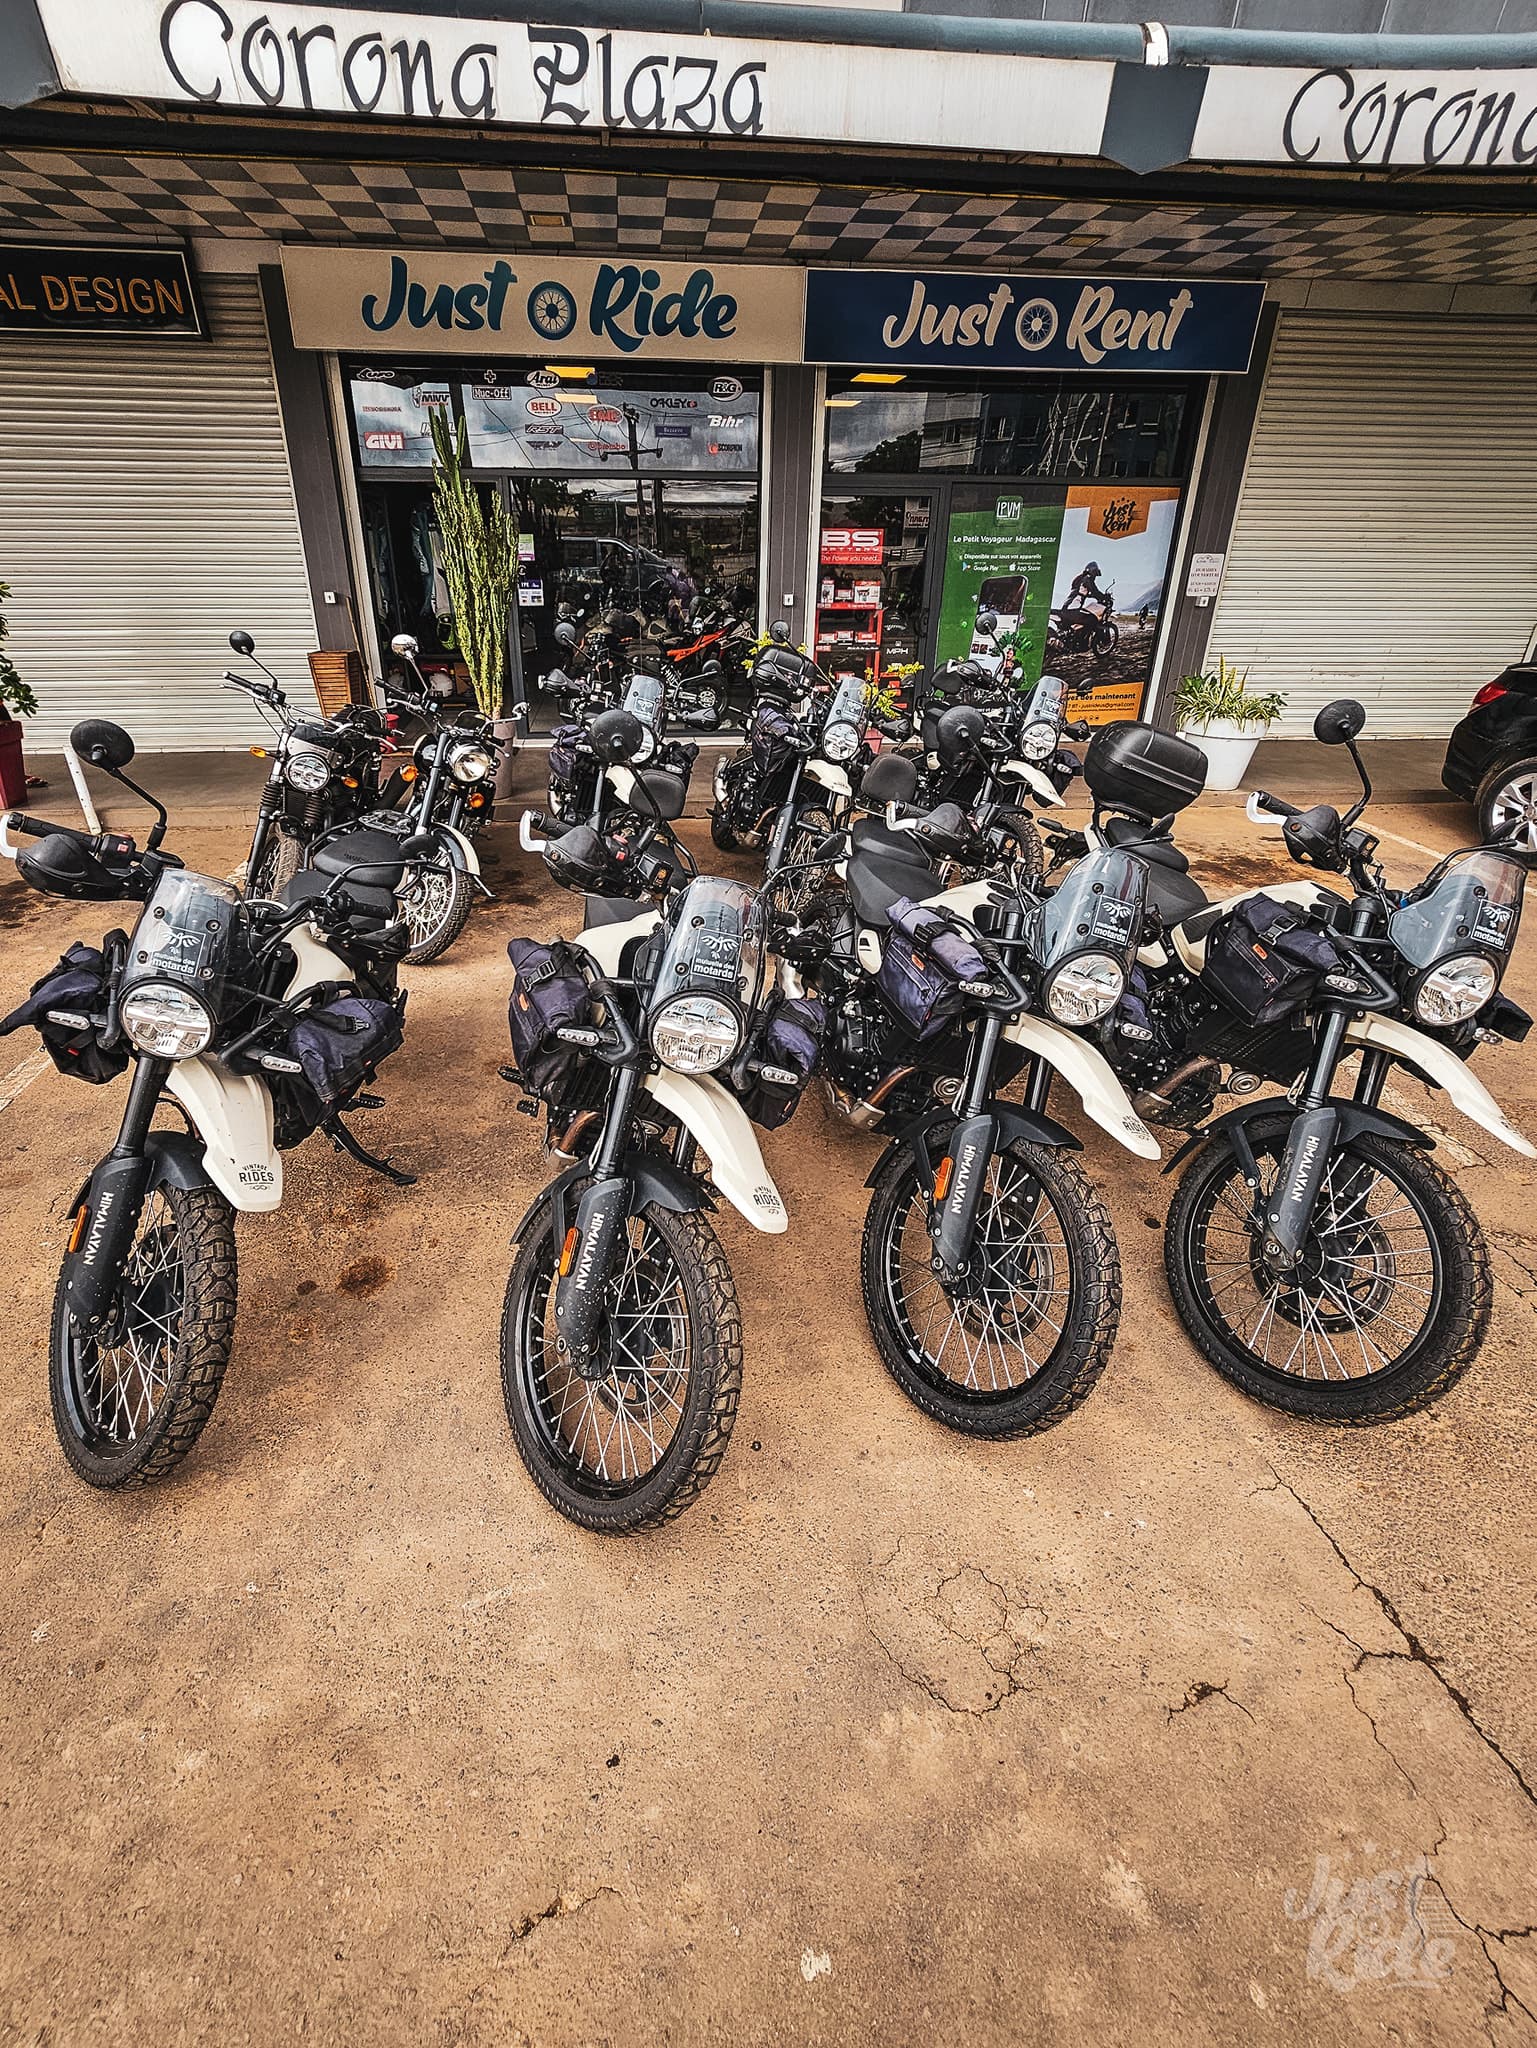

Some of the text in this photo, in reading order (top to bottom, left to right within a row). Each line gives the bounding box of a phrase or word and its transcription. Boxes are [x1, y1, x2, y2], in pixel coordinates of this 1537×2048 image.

[160, 0, 767, 136] Corona Plaza
[41, 275, 185, 314] DESIGN
[361, 256, 738, 352] Just Ride
[882, 280, 1194, 364] Just Rent
[530, 371, 559, 384] Arai
[474, 388, 509, 399] Muc-Off
[713, 381, 737, 394] R&G
[531, 402, 557, 411] BELL
[650, 398, 687, 408] OAKLEY
[707, 414, 744, 428] Bihr
[366, 434, 403, 449] GIVI
[1103, 500, 1136, 518] Just
[1102, 516, 1134, 534] Rent
[821, 530, 880, 547] BS
[963, 535, 979, 543] Petit
[981, 536, 1013, 544] Voyageur
[1015, 536, 1057, 544] Madagascar
[886, 647, 909, 655] MPH
[1094, 692, 1136, 701] maintenant
[1094, 927, 1126, 943] motards
[1474, 930, 1504, 946] motards
[152, 958, 195, 974] motards
[693, 964, 734, 979] motards
[1291, 1135, 1320, 1202] HIMALAYAN
[239, 1171, 274, 1183] RIDES
[951, 1144, 977, 1214] HIMALAYAN
[83, 1191, 115, 1266] HIMALAYAN
[575, 1212, 605, 1290] HIMALAYAN
